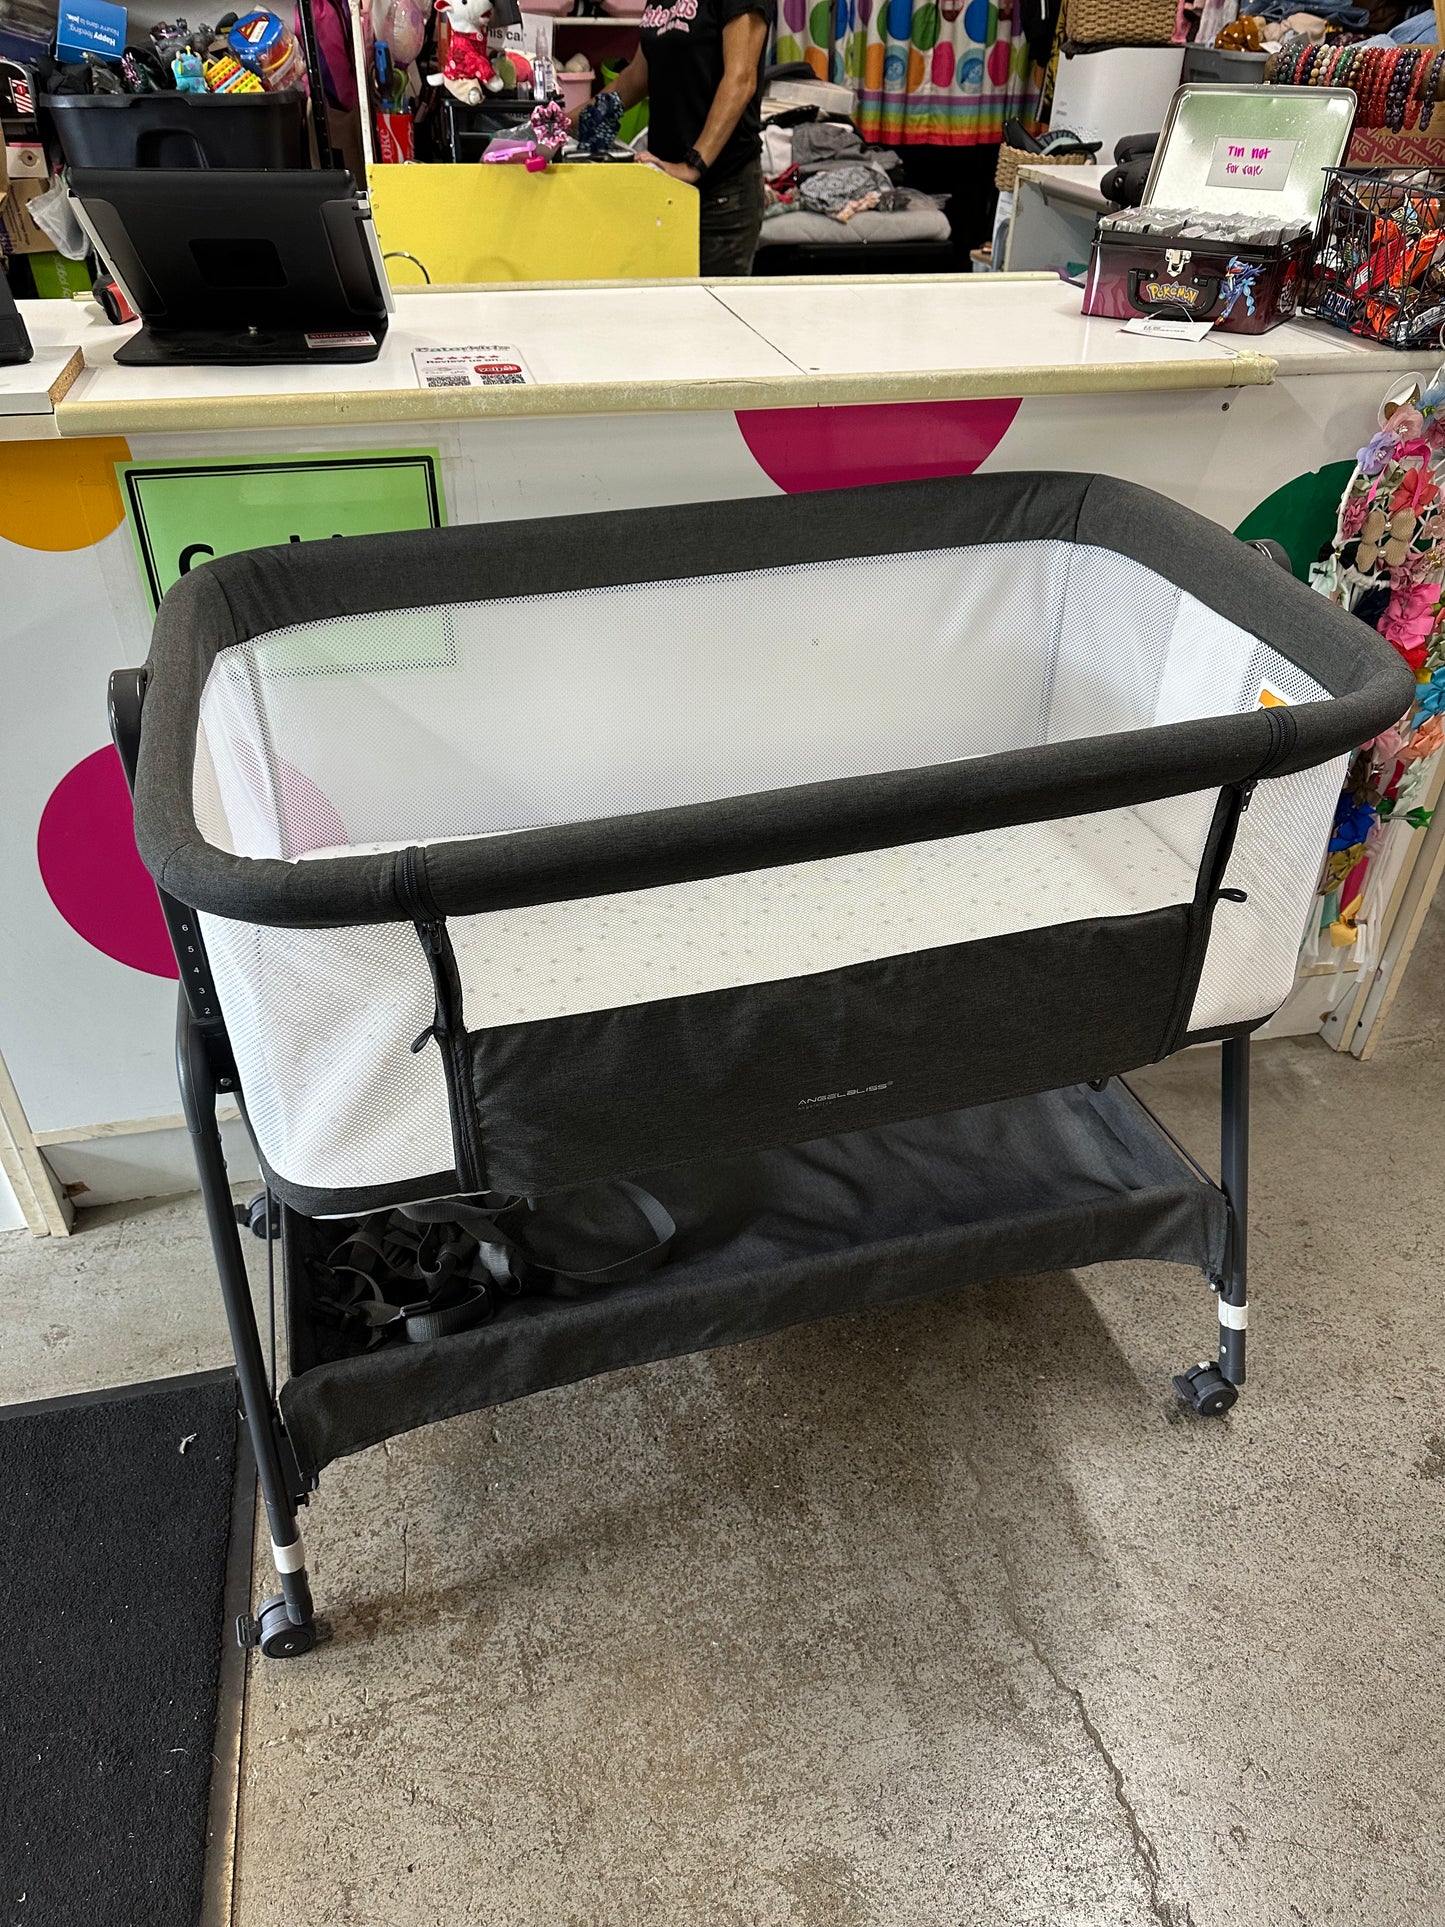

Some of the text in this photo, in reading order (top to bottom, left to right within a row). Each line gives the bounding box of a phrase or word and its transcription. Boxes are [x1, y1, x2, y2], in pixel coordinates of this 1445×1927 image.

[93, 32, 116, 46] Happy
[1251, 147, 1272, 160] not
[1242, 165, 1263, 177] sale
[181, 924, 189, 932] 6
